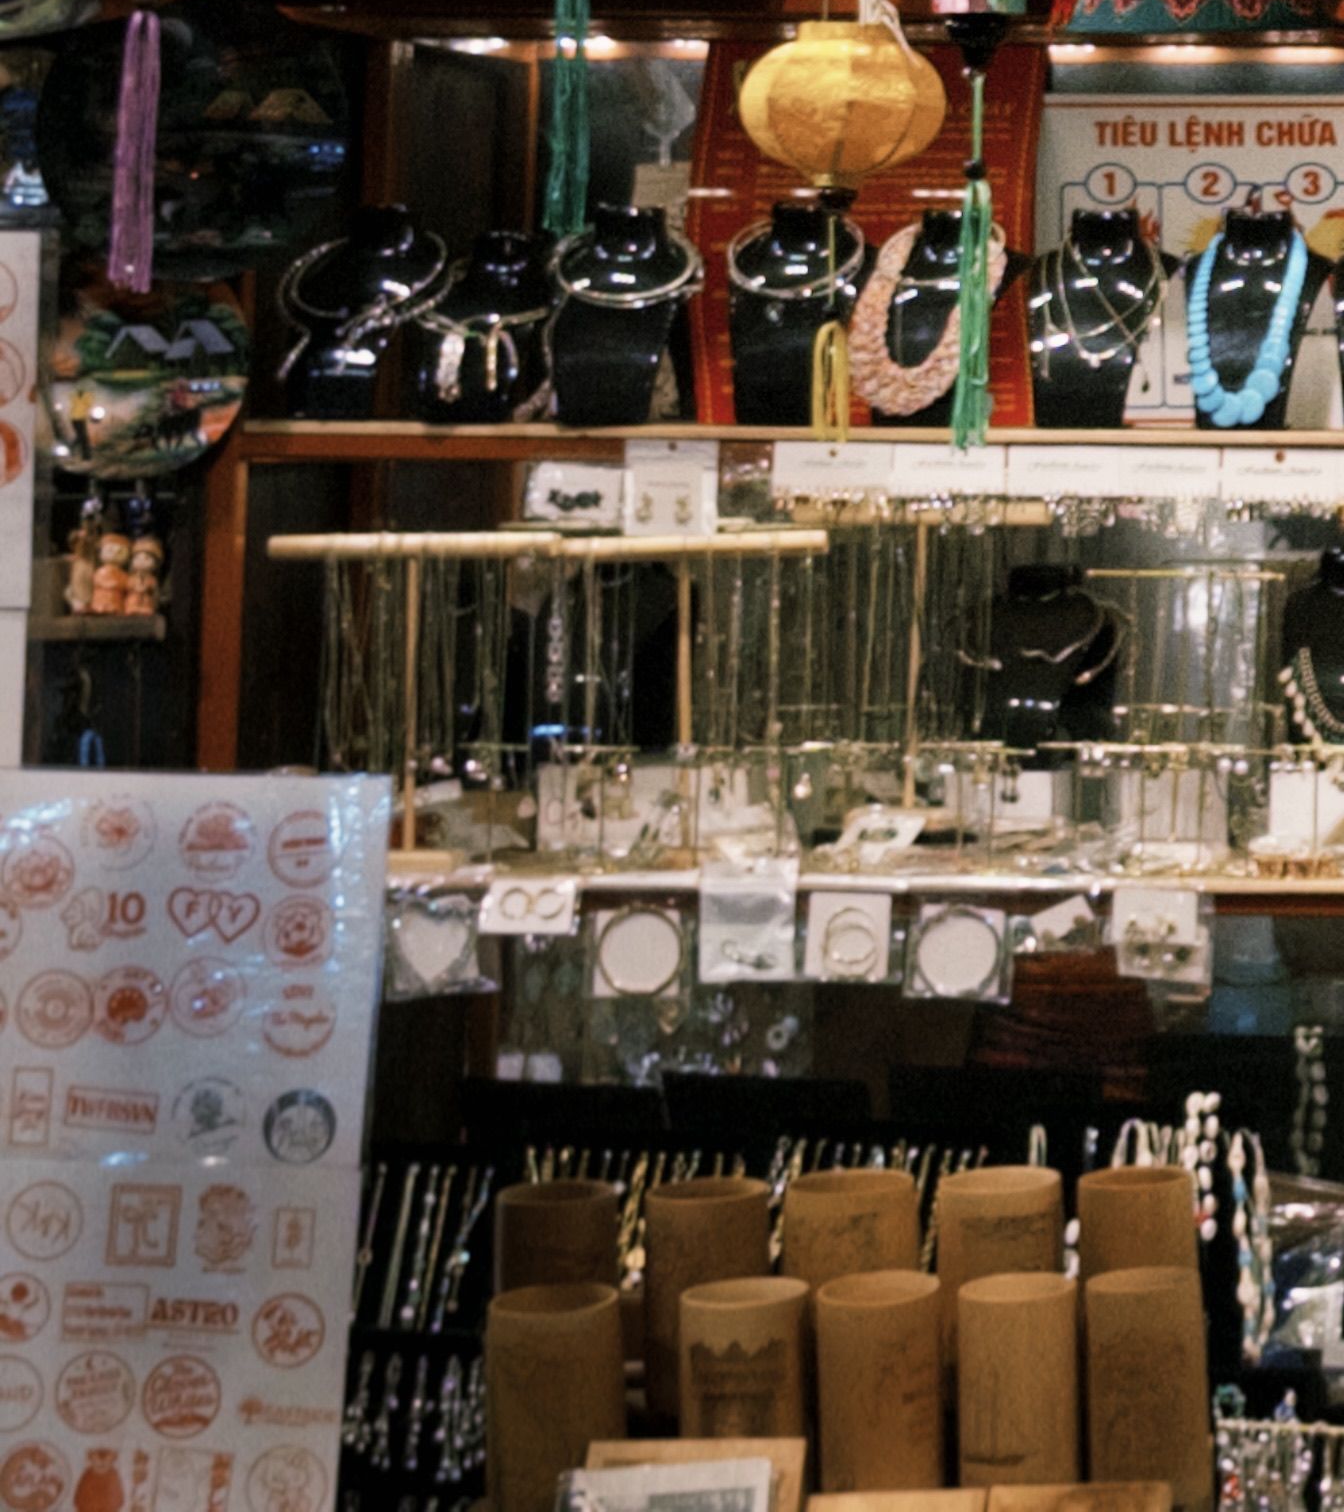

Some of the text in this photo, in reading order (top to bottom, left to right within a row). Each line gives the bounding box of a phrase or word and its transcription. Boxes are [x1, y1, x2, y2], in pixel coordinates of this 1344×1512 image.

[1094, 115, 1157, 147] TIÊU
[1168, 115, 1244, 152] LỆNH
[1256, 115, 1337, 147] CHỮA
[1102, 172, 1117, 196] 1
[1202, 171, 1221, 197] 2
[1302, 171, 1321, 197] 3
[151, 1298, 240, 1327] ASTRO
